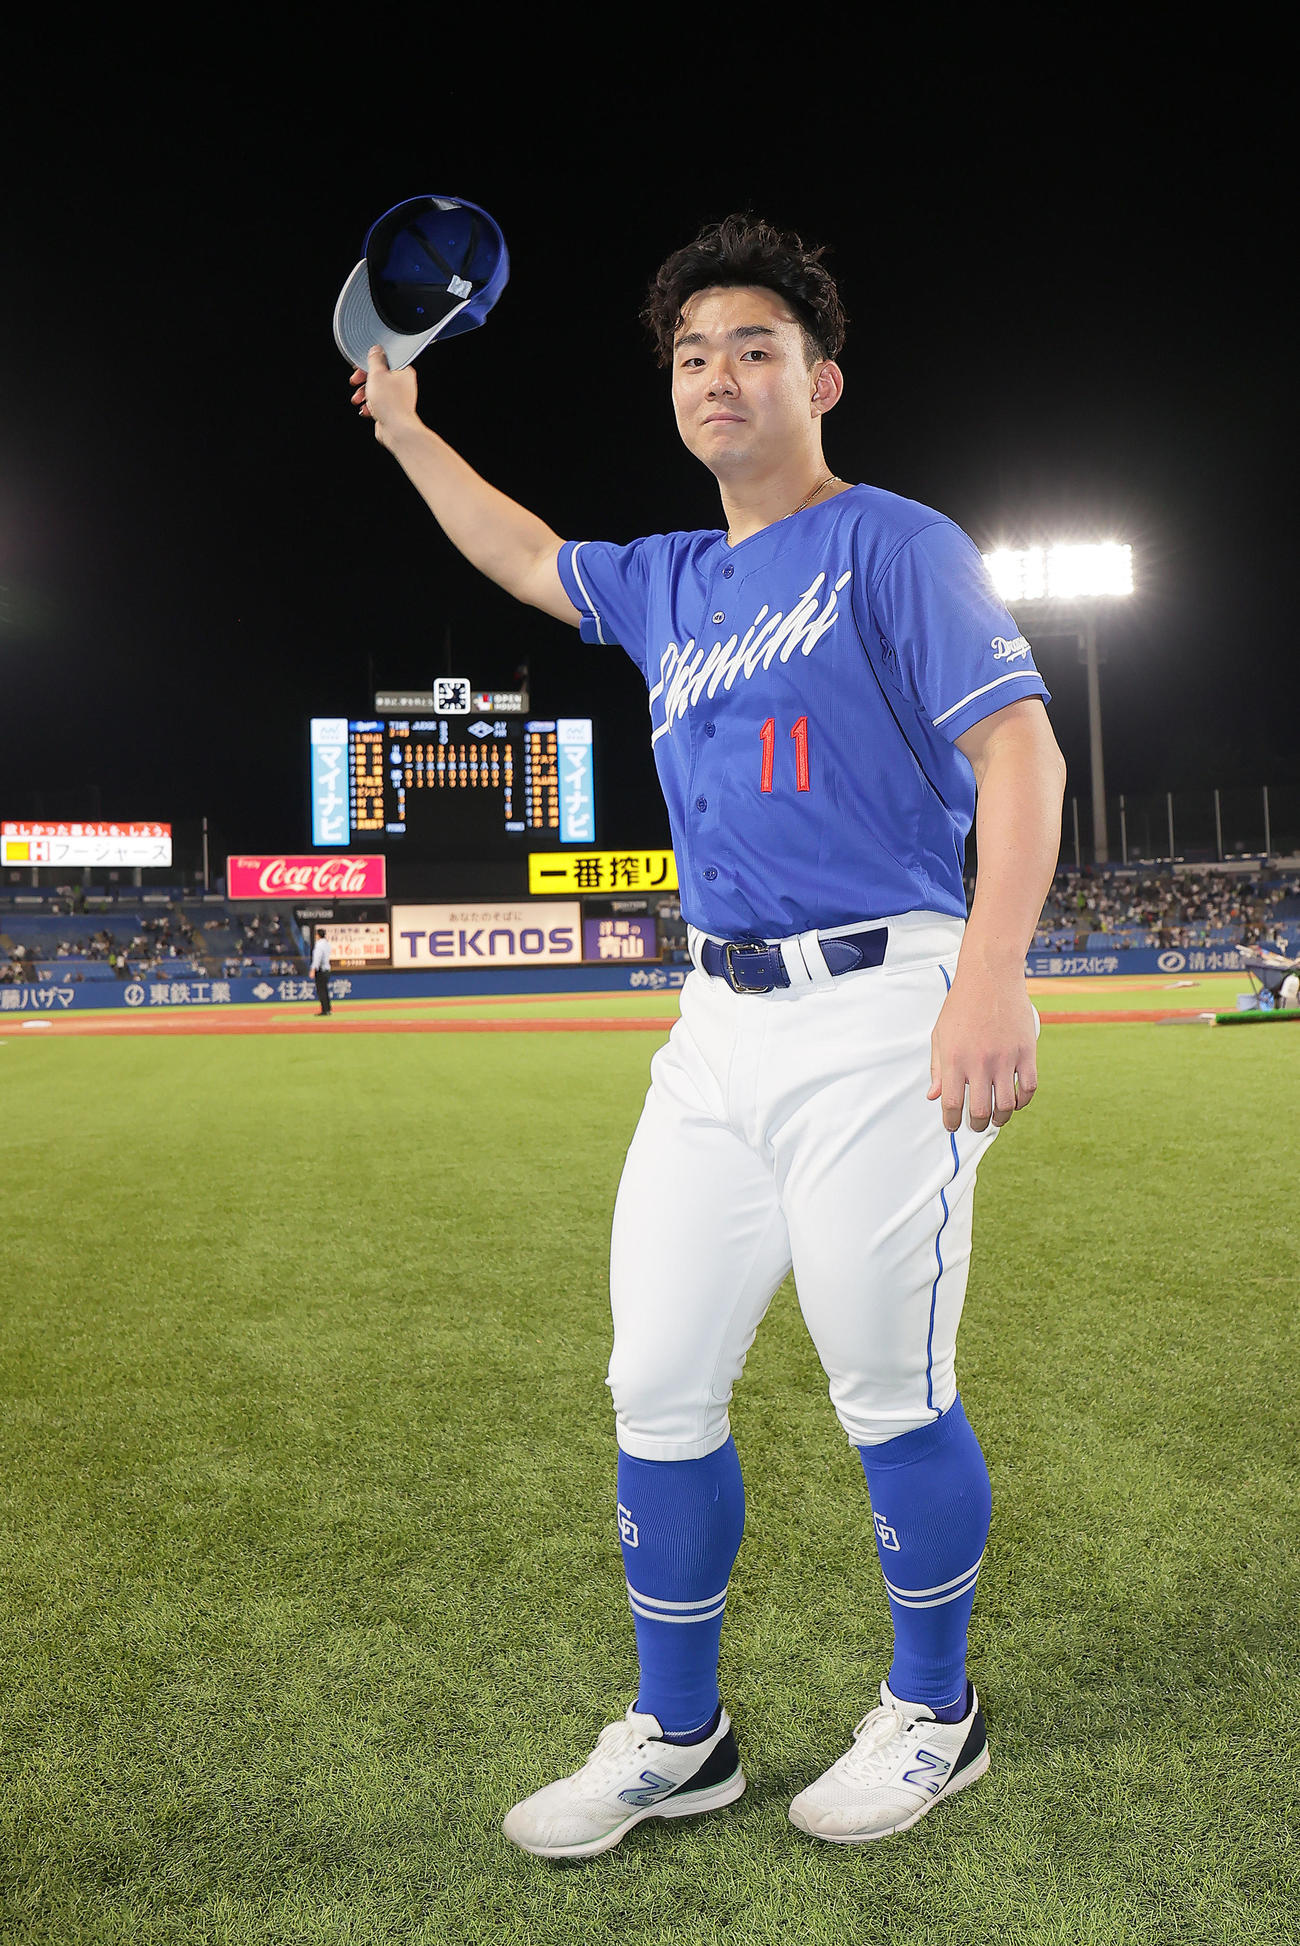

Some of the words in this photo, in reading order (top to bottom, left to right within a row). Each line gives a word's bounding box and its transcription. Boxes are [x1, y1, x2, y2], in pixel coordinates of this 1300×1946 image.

[759, 716, 810, 792] 11
[317, 746, 344, 840] マイナビ
[564, 745, 590, 838] マイナビ
[540, 857, 667, 887] 一番搾り
[449, 911, 523, 922] あなたのそばに
[400, 928, 573, 958] TEKNOS
[1035, 956, 1118, 975] 三菱ガス化学
[1188, 951, 1247, 971] 清水建
[149, 982, 231, 1005] 東鉄工業
[278, 979, 352, 1000] 住友学
